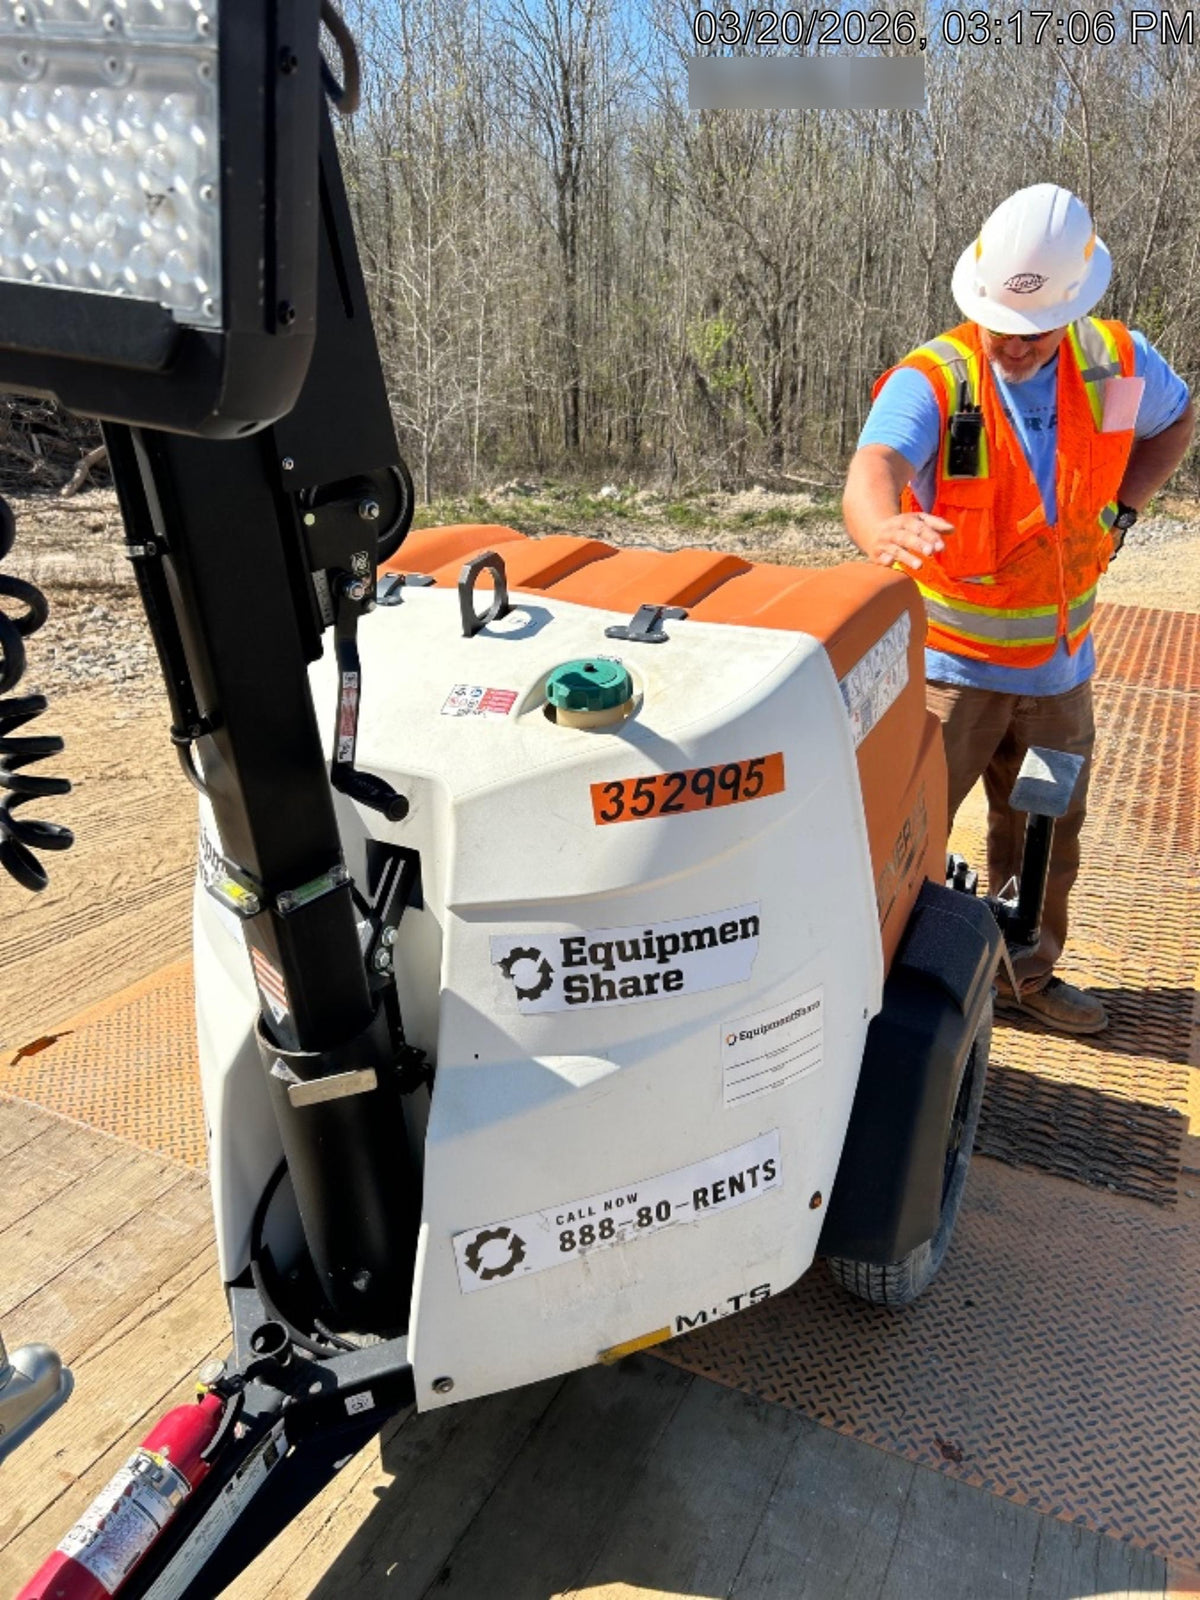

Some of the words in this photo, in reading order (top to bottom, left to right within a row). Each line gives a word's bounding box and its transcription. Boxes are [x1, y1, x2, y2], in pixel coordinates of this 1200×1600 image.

[600, 758, 765, 822] 352995
[563, 968, 684, 1004] Share
[555, 1206, 596, 1226] CALL
[604, 1192, 638, 1212] NOW
[558, 1158, 776, 1253] 888-80-RENTS
[675, 1283, 771, 1332] MTS
